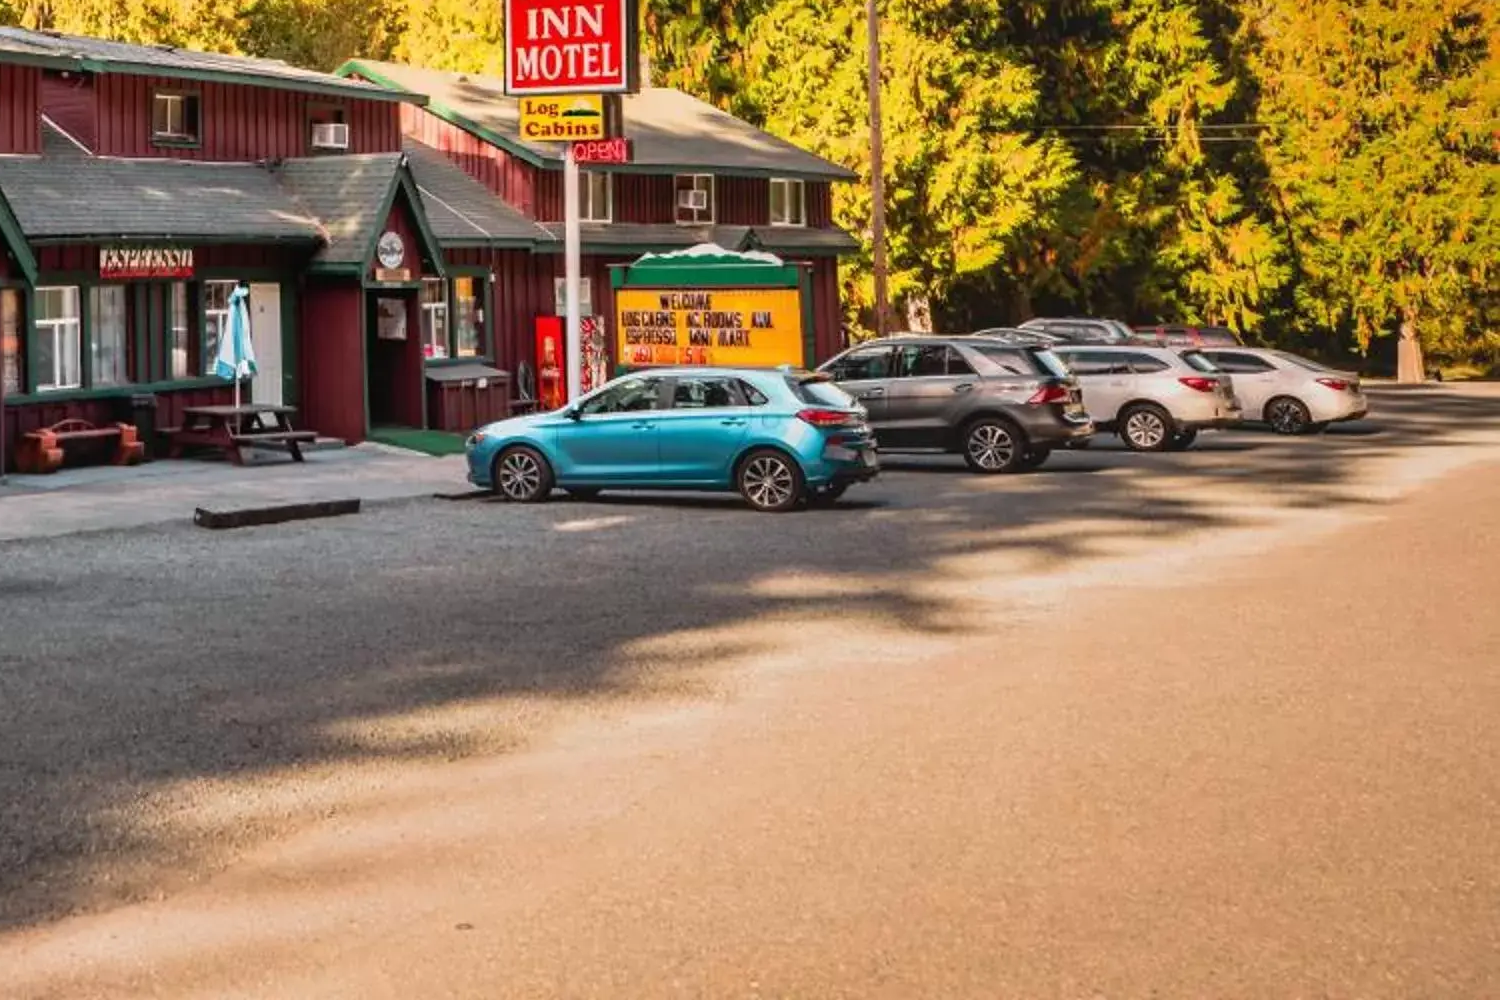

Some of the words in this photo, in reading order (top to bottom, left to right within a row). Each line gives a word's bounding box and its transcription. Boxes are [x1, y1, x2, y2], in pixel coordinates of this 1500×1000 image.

[526, 4, 605, 40] INN
[515, 43, 619, 81] MOTEL
[525, 101, 559, 117] Log
[525, 122, 600, 137] Cabins
[573, 139, 627, 162] OPEN
[660, 293, 713, 310] WELCOME
[703, 311, 743, 328] ROOMS
